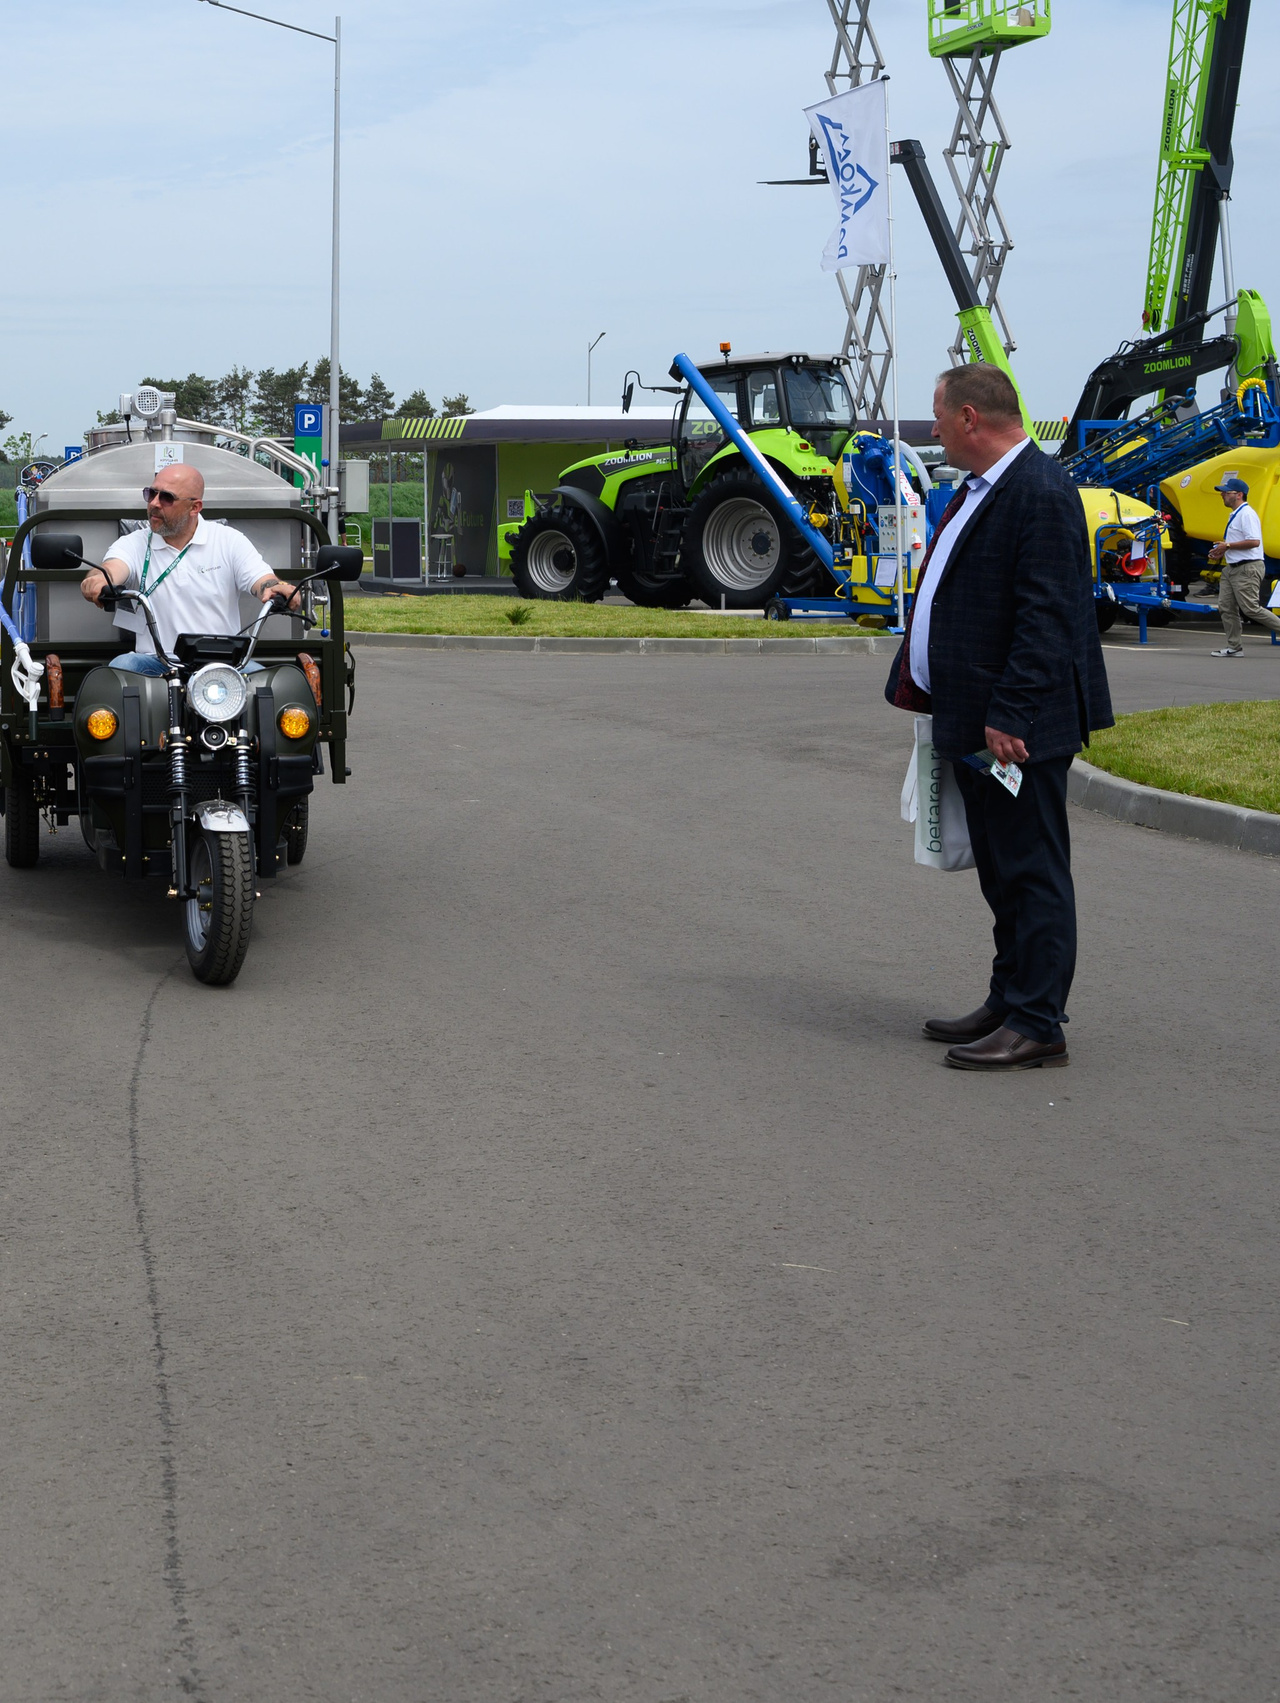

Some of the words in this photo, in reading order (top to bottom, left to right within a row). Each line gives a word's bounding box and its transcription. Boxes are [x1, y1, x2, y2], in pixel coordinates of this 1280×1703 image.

[1164, 88, 1176, 152] ZOOMLION
[967, 328, 985, 363] ZOOMLI
[1143, 355, 1191, 374] ZOOMLION
[304, 413, 315, 429] P
[604, 452, 653, 466] ZOOMLION
[926, 747, 943, 853] betaren.r
